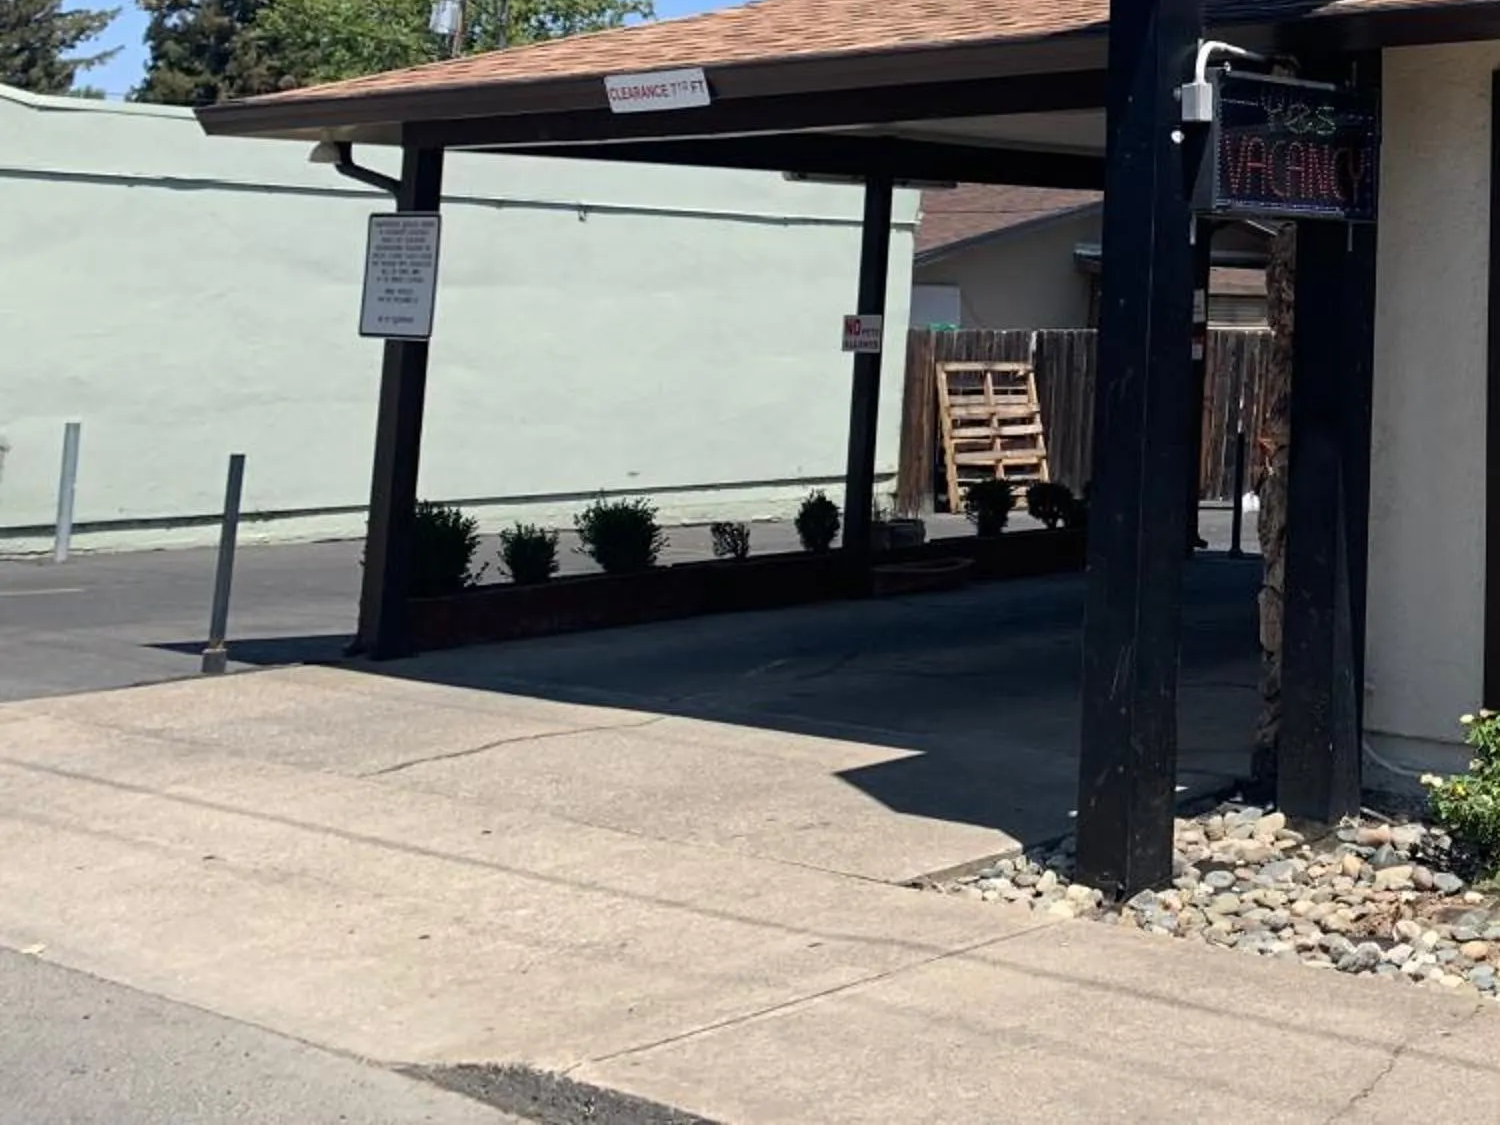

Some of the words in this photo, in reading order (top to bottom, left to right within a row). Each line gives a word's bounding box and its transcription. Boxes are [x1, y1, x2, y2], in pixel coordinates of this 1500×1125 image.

[609, 83, 671, 102] CLEARANCE
[1222, 132, 1367, 205] VACANCY
[844, 318, 862, 336] NO
